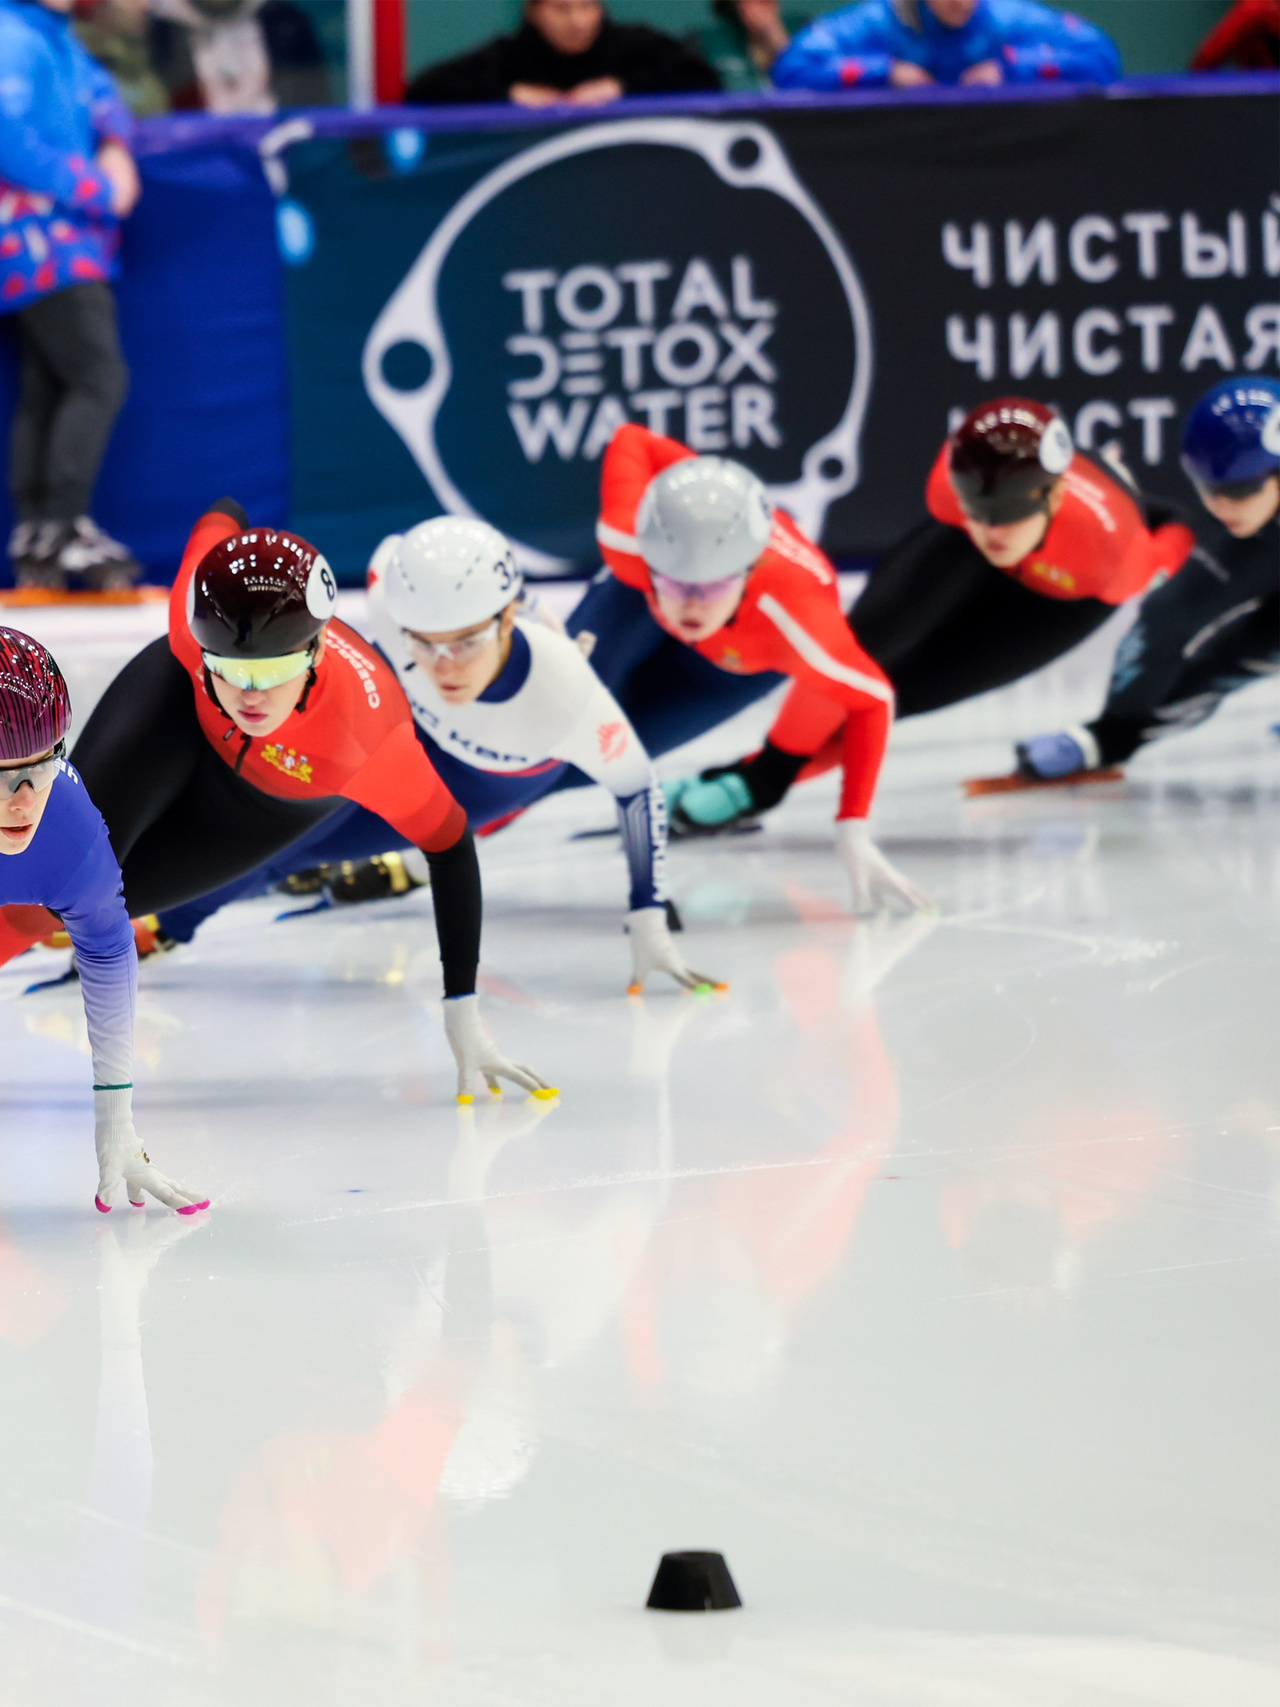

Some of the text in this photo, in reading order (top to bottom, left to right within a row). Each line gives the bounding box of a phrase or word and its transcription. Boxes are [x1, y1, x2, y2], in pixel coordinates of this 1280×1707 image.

[503, 256, 776, 332] TOTAL
[506, 321, 778, 398] DETOX
[946, 304, 1280, 381] ЧИСТАЯ
[508, 385, 781, 462] WATER
[320, 568, 335, 602] 8
